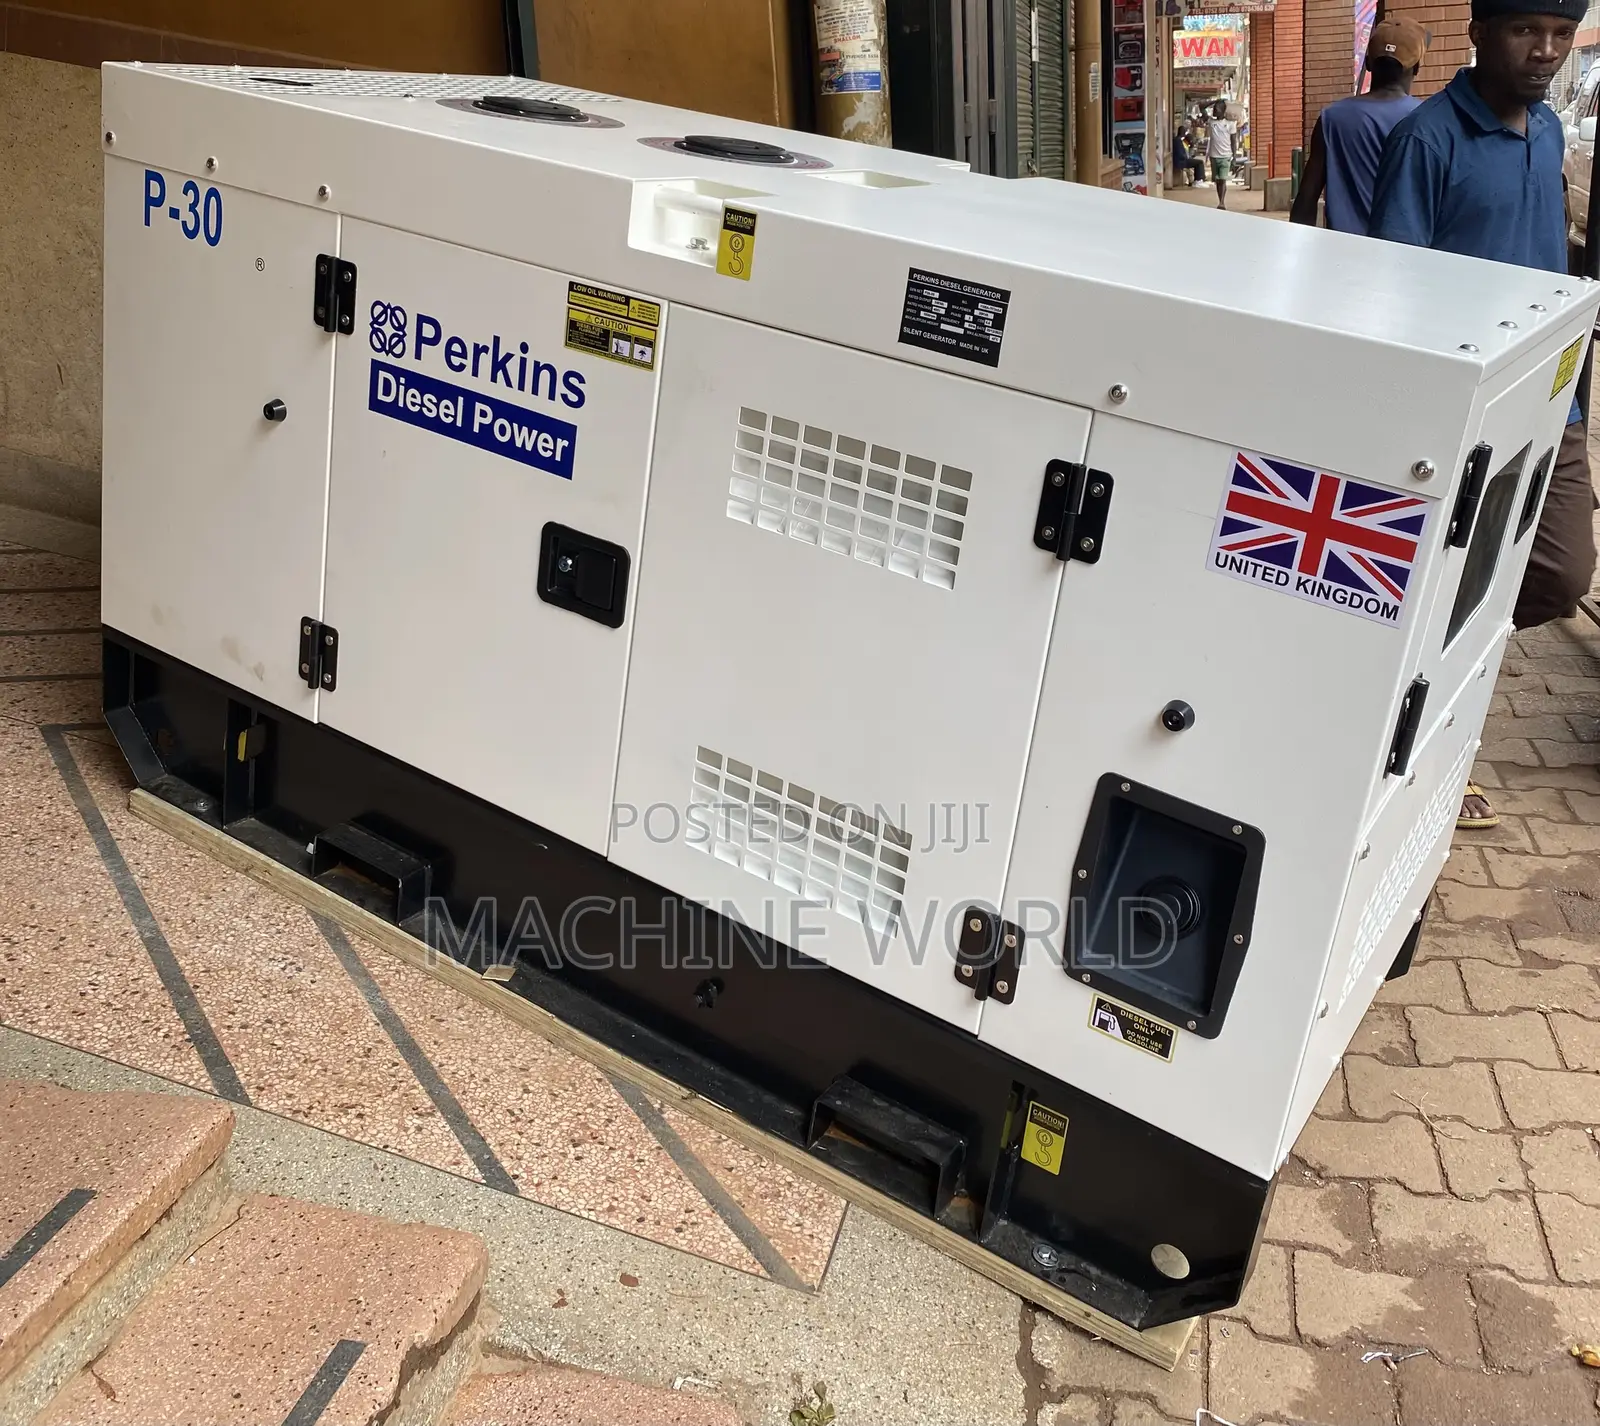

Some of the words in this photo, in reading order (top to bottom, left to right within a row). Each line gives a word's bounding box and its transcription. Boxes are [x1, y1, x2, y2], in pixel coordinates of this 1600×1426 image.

[144, 168, 223, 248] P-30
[726, 212, 755, 227] CAUTION!
[573, 284, 586, 293] LOW
[587, 288, 597, 296] OIL
[598, 290, 626, 303] WARNING
[913, 273, 939, 285] PERKINS
[940, 280, 961, 291] DIESEL
[963, 285, 1001, 300] GENERATOR
[594, 316, 629, 332] CAUTION
[903, 326, 922, 337] SILENT
[922, 332, 957, 346] GENERATOR
[960, 342, 973, 350] MADE
[414, 312, 587, 409] Perkins
[377, 369, 464, 428] Diesel
[473, 401, 570, 462] Power
[1214, 552, 1289, 587] UNITED
[1295, 576, 1399, 621] KINGDOM
[1120, 1009, 1150, 1027] DIESEL
[1150, 1022, 1171, 1037] FUEL
[1133, 1022, 1156, 1036] ONLY
[1126, 1029, 1136, 1037] DO
[1136, 1034, 1150, 1044] NOT
[1150, 1040, 1163, 1050] USE
[1128, 1036, 1160, 1053] GASOLINE
[1032, 1108, 1065, 1128] CAUTION!
